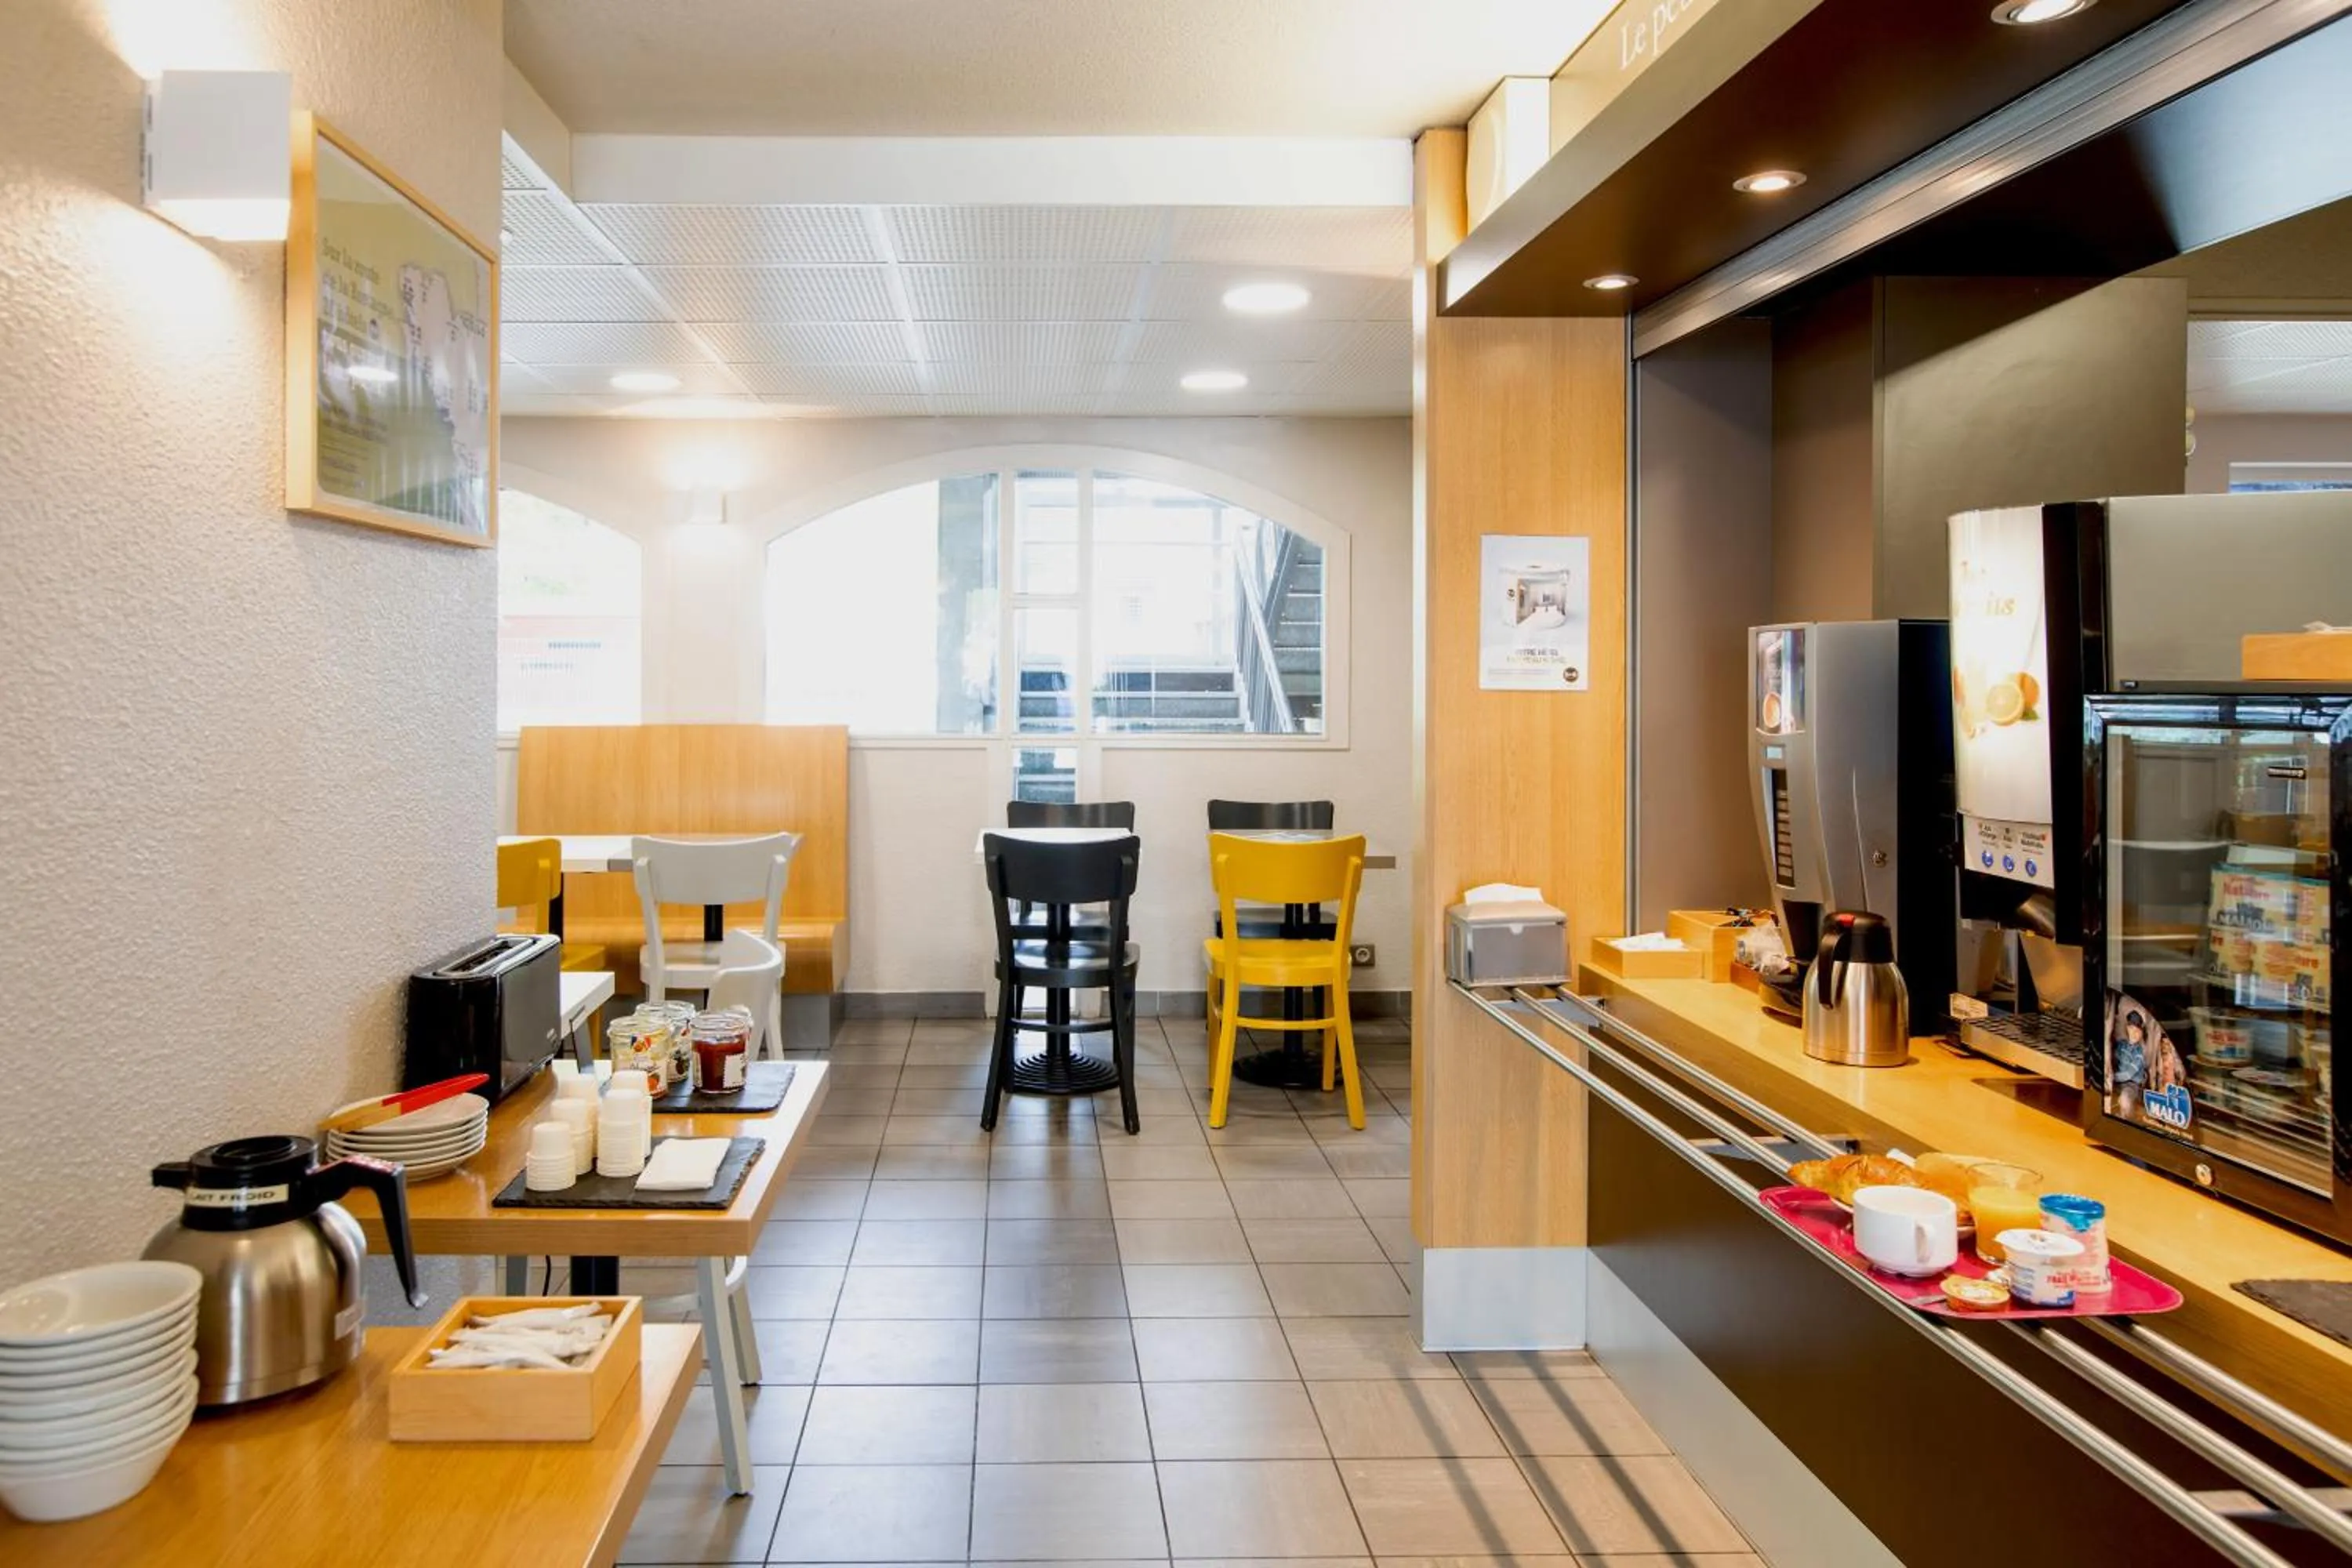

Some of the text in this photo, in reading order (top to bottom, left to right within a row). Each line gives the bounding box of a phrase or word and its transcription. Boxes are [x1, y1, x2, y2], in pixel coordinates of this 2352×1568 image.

[1620, 0, 1693, 71] Le pe
[2149, 1101, 2186, 1127] MALO
